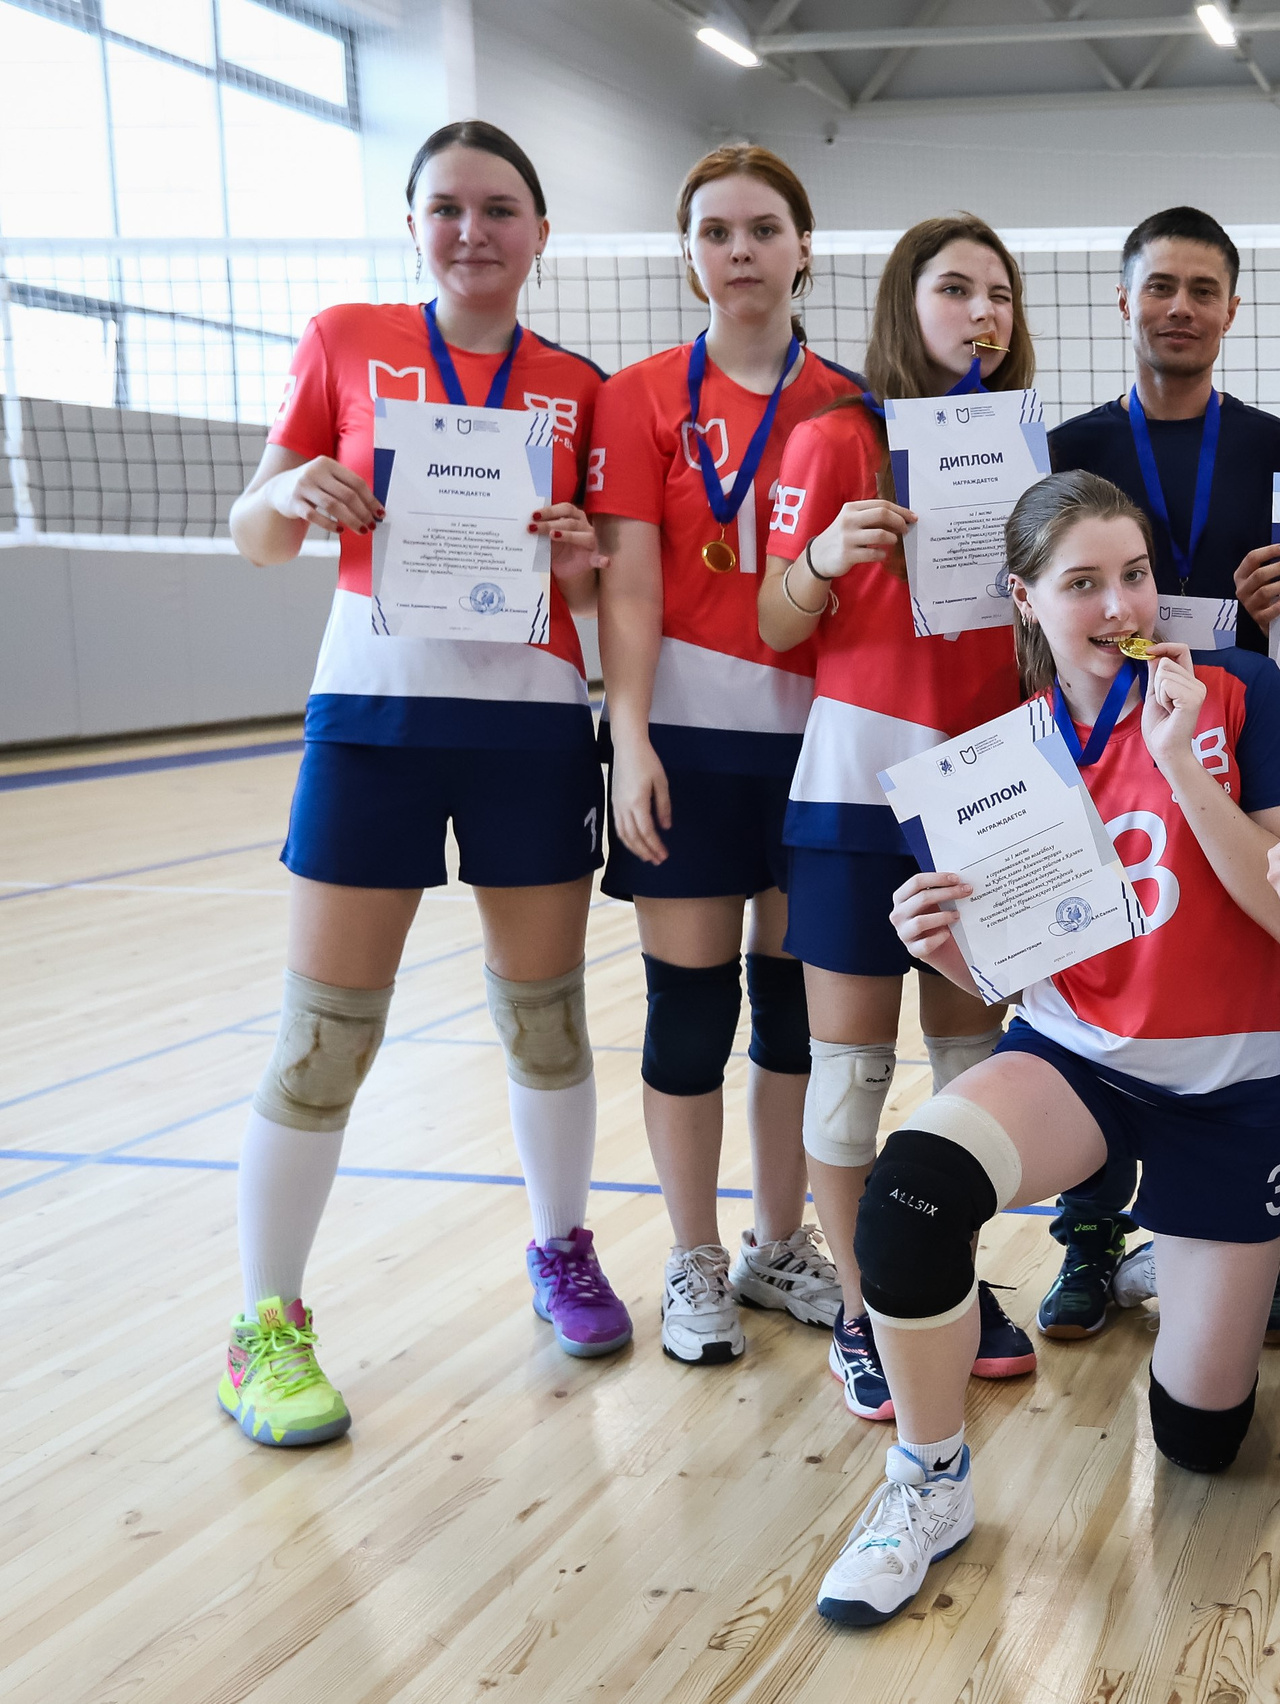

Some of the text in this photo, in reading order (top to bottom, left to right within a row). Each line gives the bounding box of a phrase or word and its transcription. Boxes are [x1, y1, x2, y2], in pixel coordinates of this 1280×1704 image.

[427, 463, 500, 480] ДИПЛОМ
[939, 452, 1003, 471] ДИПЛОМ
[952, 477, 998, 486] НАГРАЖДАЕТСЯ
[957, 780, 1027, 825] ДИПЛОМ
[977, 809, 1027, 835] НАГРАЖДАЕТСЯ
[889, 1187, 939, 1217] ALLSIX
